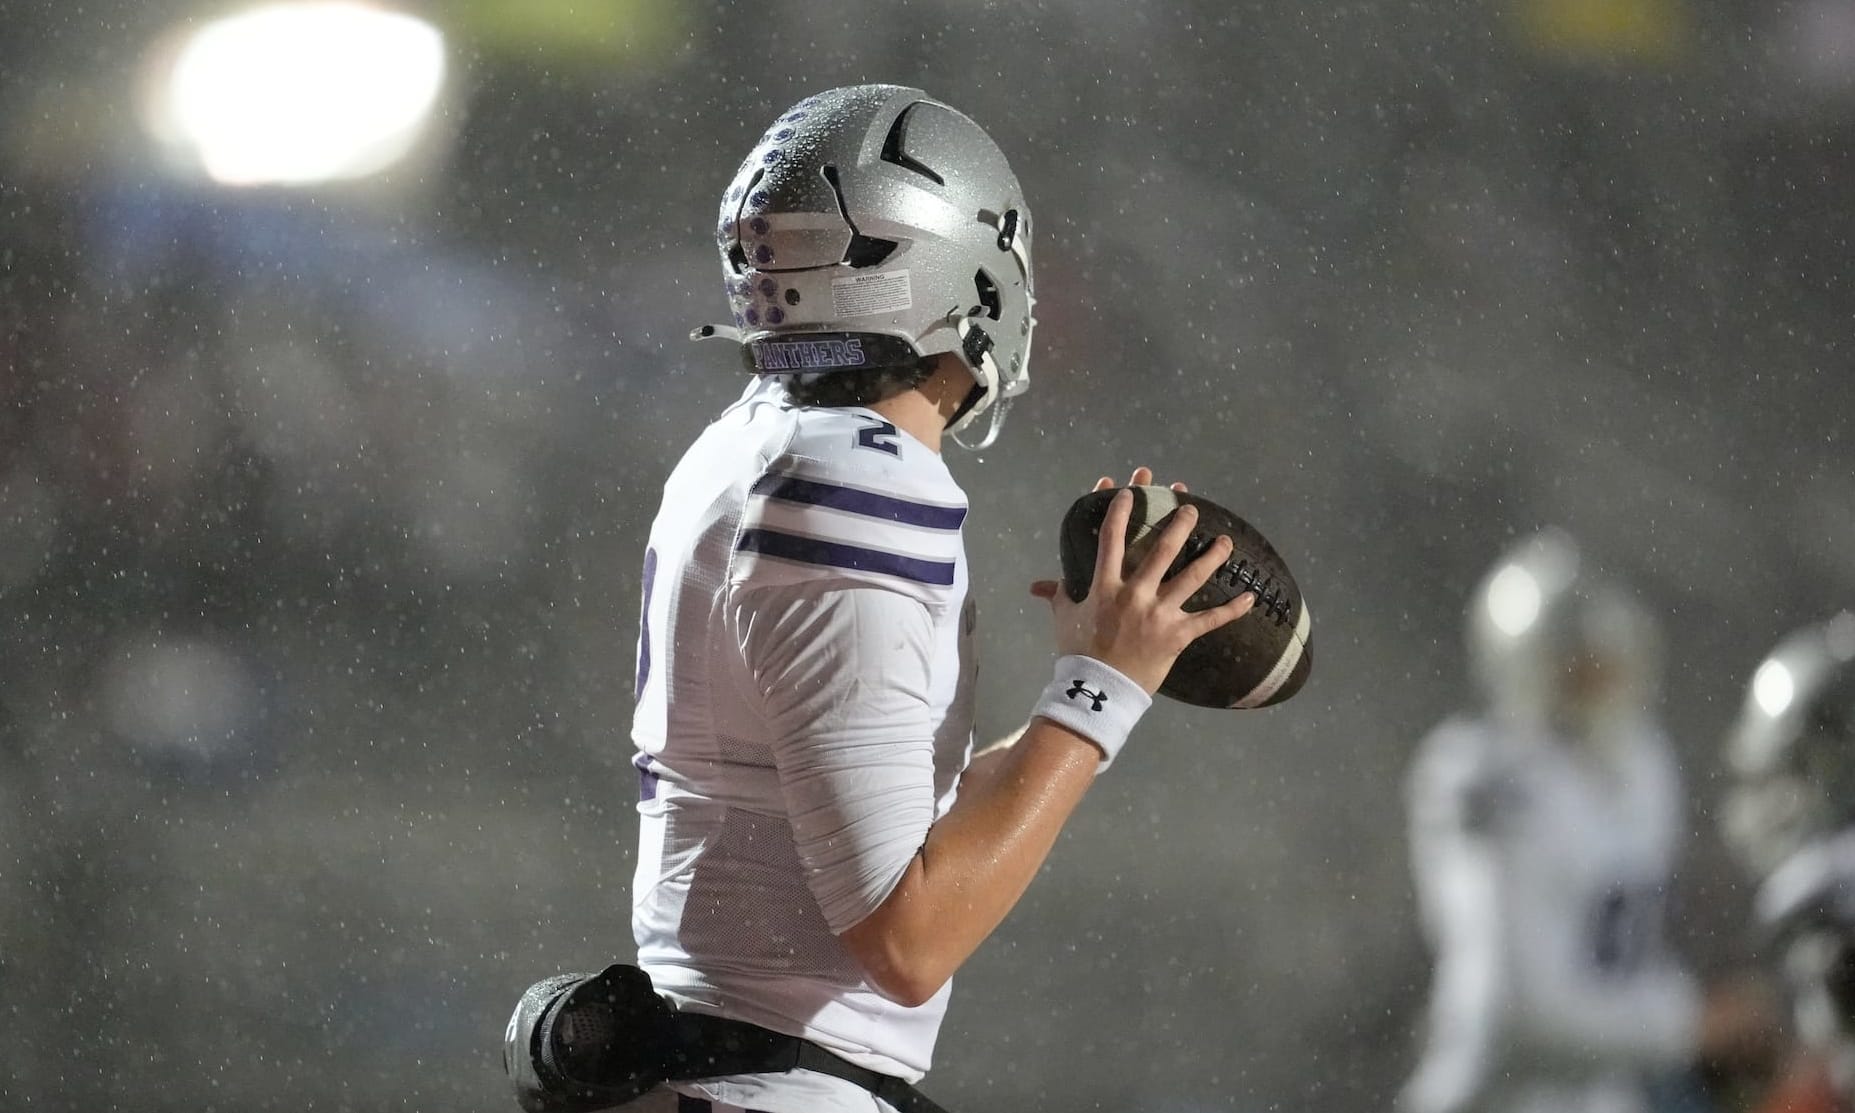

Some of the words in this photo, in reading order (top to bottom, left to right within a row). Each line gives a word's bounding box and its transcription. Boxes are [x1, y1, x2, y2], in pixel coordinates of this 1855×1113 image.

[855, 274, 885, 283] WARNING
[752, 339, 865, 369] PANTHERS
[854, 413, 903, 460] 2
